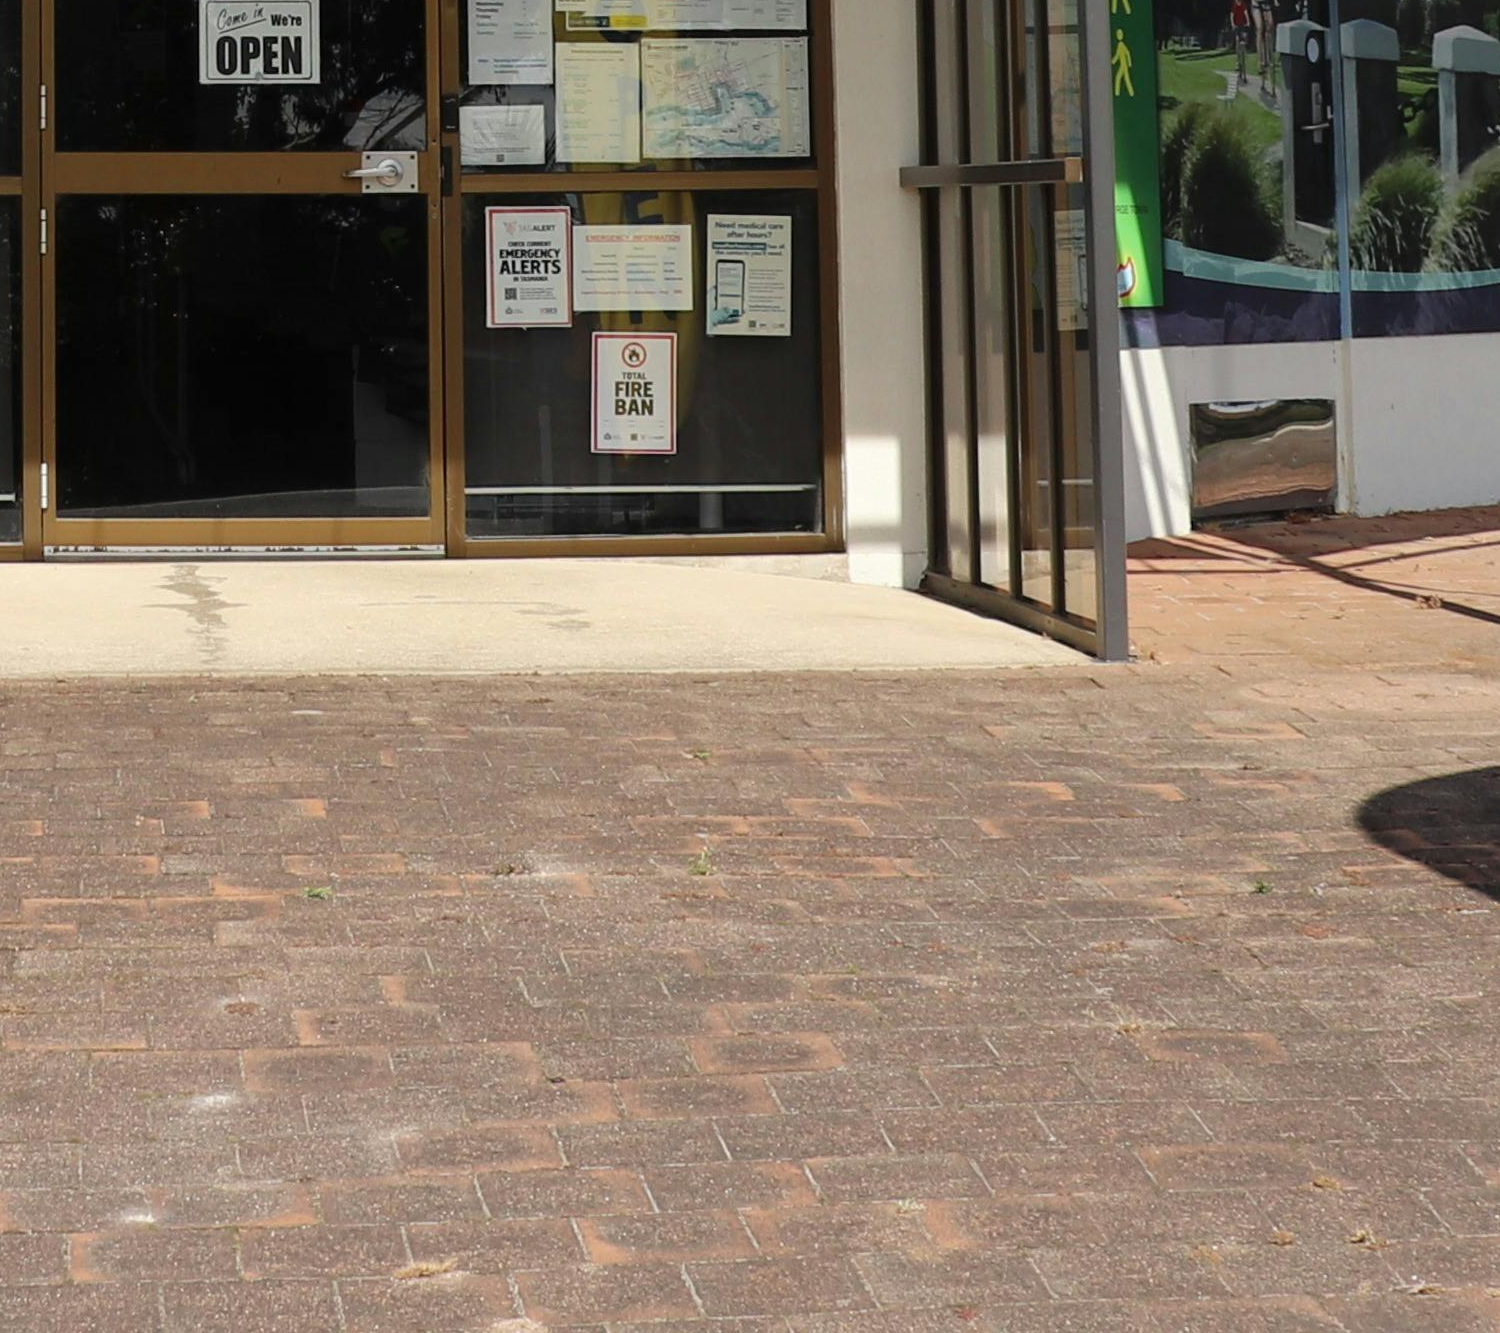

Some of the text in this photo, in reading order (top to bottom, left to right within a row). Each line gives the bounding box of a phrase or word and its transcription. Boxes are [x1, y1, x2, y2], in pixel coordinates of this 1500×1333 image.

[216, 3, 302, 31] Come in We're
[216, 35, 303, 76] OPEN
[715, 221, 736, 229] Need
[727, 230, 773, 238] after hours?
[499, 249, 561, 258] EMERGENCY
[499, 260, 562, 274] ALERTS
[622, 372, 647, 380] TOTAL
[615, 381, 654, 398] FIRE
[615, 398, 654, 416] BAN
